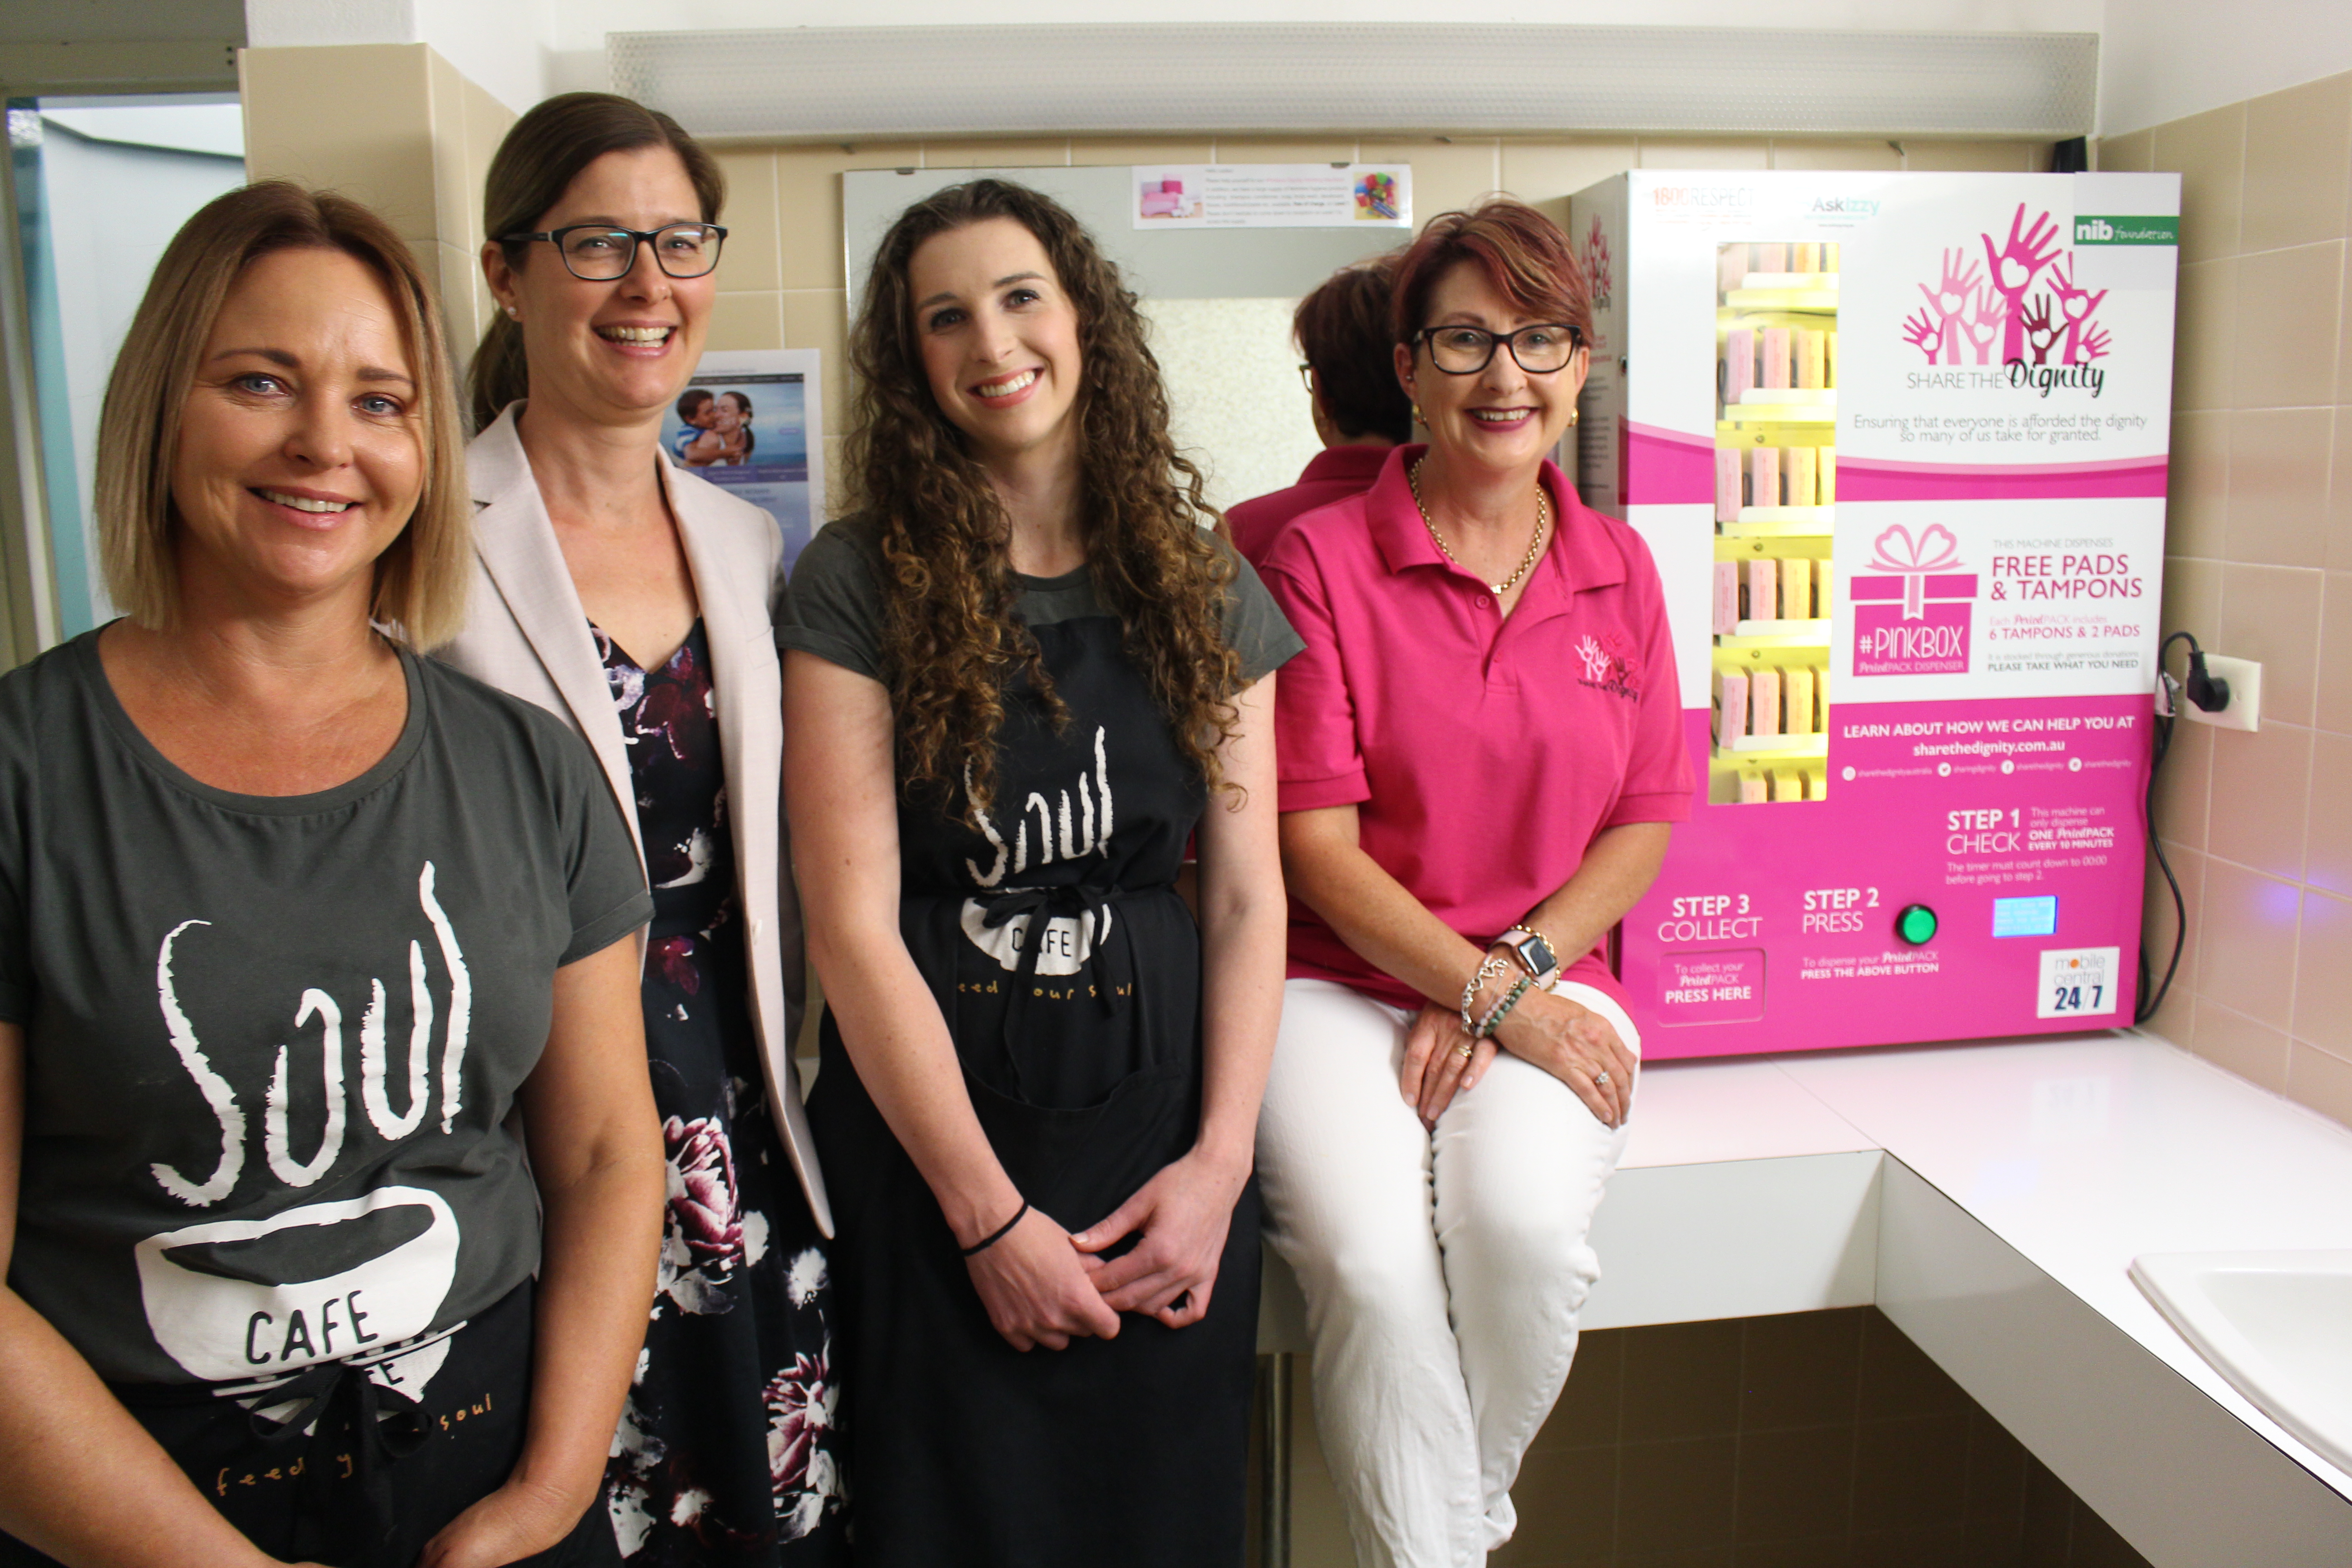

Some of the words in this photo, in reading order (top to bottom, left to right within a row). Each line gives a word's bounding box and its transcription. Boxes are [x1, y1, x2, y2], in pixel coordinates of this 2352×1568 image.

[2077, 220, 2113, 240] nib
[1907, 372, 1965, 389] SHARE
[1970, 372, 2004, 388] THE
[2004, 358, 2104, 398] Dignity
[1855, 414, 1909, 431] Ensuring
[1914, 414, 1939, 428] that
[1943, 416, 2004, 431] everyone
[2009, 413, 2017, 427] is
[2022, 413, 2076, 428] afforded
[2081, 413, 2101, 427] the
[2106, 413, 2147, 431] dignity
[1900, 431, 1915, 442] so
[1920, 431, 1955, 445] many
[1960, 429, 1972, 442] of
[1977, 431, 1991, 442] us
[1996, 428, 2022, 441] take
[2027, 428, 2045, 441] for
[2049, 427, 2101, 445] granted.
[1994, 539, 2013, 549] THIS
[2017, 538, 2062, 549] MACHINE
[2065, 537, 2113, 548] DISPENSES
[1993, 555, 2052, 577] FREE
[2063, 554, 2129, 575] PADS
[1991, 581, 2007, 600] &
[2017, 578, 2142, 600] TAMPONS
[1989, 616, 2010, 625] Each
[1989, 628, 1996, 640] 6
[2002, 627, 2073, 640] TAMPONS
[2078, 626, 2087, 638] &
[2092, 625, 2099, 638] 2
[2104, 624, 2140, 637] PADS
[1859, 625, 1964, 659] #PINKBOX
[1915, 659, 1965, 672] DISPENSER
[1988, 663, 2022, 672] PLEASE
[2026, 662, 2051, 671] TAKE
[2053, 661, 2084, 670] WHAT
[2088, 661, 2108, 669] YOU
[2112, 659, 2139, 668] NEED
[1843, 724, 1891, 739] LEARN
[1893, 721, 1944, 736] ABOUT
[1946, 720, 1984, 735] HOW
[1986, 719, 2010, 733] WE
[2012, 718, 2044, 732] CAN
[2046, 717, 2082, 731] HELP
[2084, 716, 2114, 730] YOU
[2117, 715, 2136, 729] AT
[1913, 740, 2066, 758] sharethedignity.com.au
[1947, 808, 2003, 831] STEP
[2010, 808, 2020, 829] 1
[2031, 807, 2049, 817] This
[2051, 807, 2087, 817] machine
[2089, 807, 2105, 816] can
[2030, 818, 2049, 829] only
[1947, 831, 2021, 855] CHECK
[2028, 829, 2054, 841] ONE
[2028, 841, 2058, 852] EVERY
[2060, 840, 2071, 850] 10
[2072, 839, 2114, 849] MINUTES
[1947, 862, 1965, 872] The
[1967, 861, 1990, 871] timer
[1992, 860, 2014, 870] must
[2016, 859, 2041, 870] count
[2043, 858, 2069, 869] down
[2071, 858, 2081, 867] to
[1945, 875, 1975, 885] before
[1976, 874, 2001, 886] going
[2003, 873, 2014, 882] to
[2015, 872, 2034, 883] step
[1672, 895, 1731, 918] STEP
[1737, 893, 1750, 915] 3
[1803, 887, 1861, 911] STEP
[1867, 887, 1879, 908] 2
[1657, 916, 1764, 943] COLLECT
[1802, 911, 1864, 934] PRESS
[1011, 927, 1073, 958] CFE
[1674, 963, 1688, 974] To
[1690, 962, 1720, 974] collect
[1722, 962, 1745, 974] your
[1802, 956, 1816, 967] To
[1858, 956, 1880, 965] your
[2056, 955, 2105, 970] mobile
[1801, 968, 1832, 980] PRESS
[1833, 967, 1855, 978] THE
[1857, 965, 1892, 977] ABOVE
[1893, 962, 1940, 975] BUTTON
[2054, 971, 2104, 985] central
[958, 980, 998, 994] eed
[1033, 987, 1074, 1000] our
[1088, 983, 1132, 996] sul
[1665, 988, 1709, 1004] PRESS
[1712, 985, 1752, 1001] HERE
[2054, 985, 2103, 1011] 24/7
[244, 1290, 379, 1366] CAFE
[216, 1457, 306, 1497] feed
[439, 1393, 492, 1431] soul
